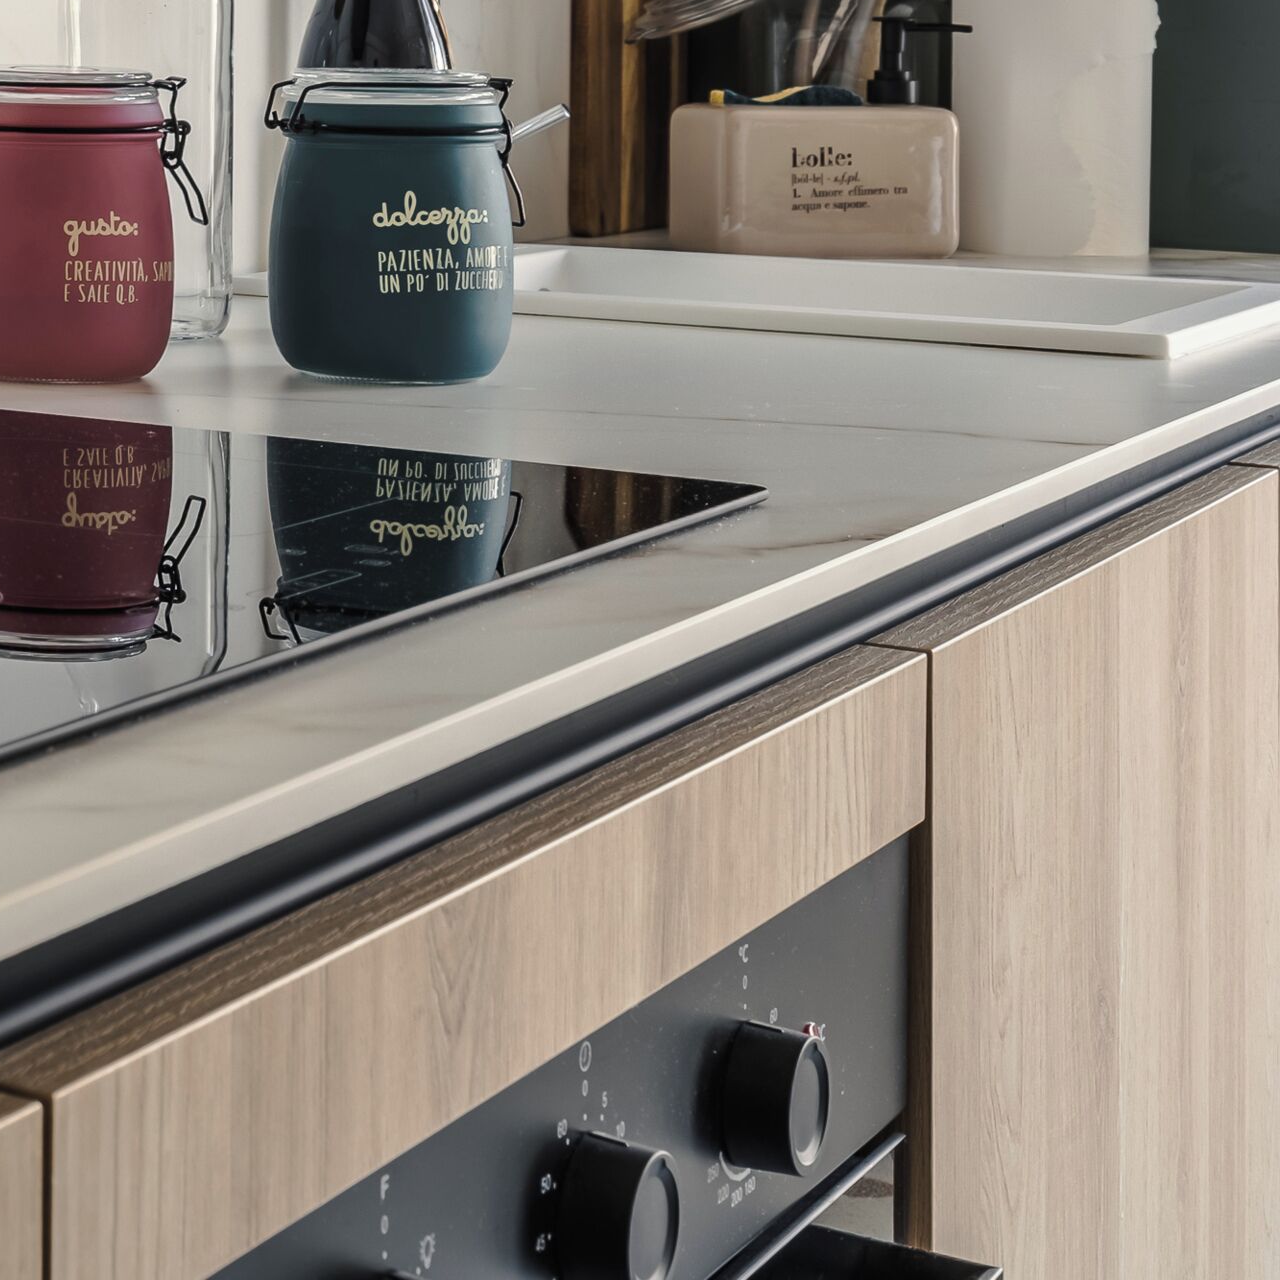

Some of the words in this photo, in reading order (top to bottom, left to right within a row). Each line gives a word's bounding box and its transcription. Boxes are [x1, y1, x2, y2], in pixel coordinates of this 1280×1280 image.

[811, 188, 843, 198] Amore
[848, 185, 890, 196] effimero
[894, 186, 909, 195] tra
[372, 190, 489, 245] dolcezza:
[791, 203, 822, 213] acqua
[63, 210, 139, 257] gusto:
[64, 258, 148, 283] CREATIVITÀ,
[377, 246, 459, 272] PAZIENZA,
[64, 283, 71, 303] E
[78, 283, 110, 303] SALE
[116, 283, 139, 305] Q.B.
[379, 273, 401, 294] UN
[436, 272, 449, 292] DI
